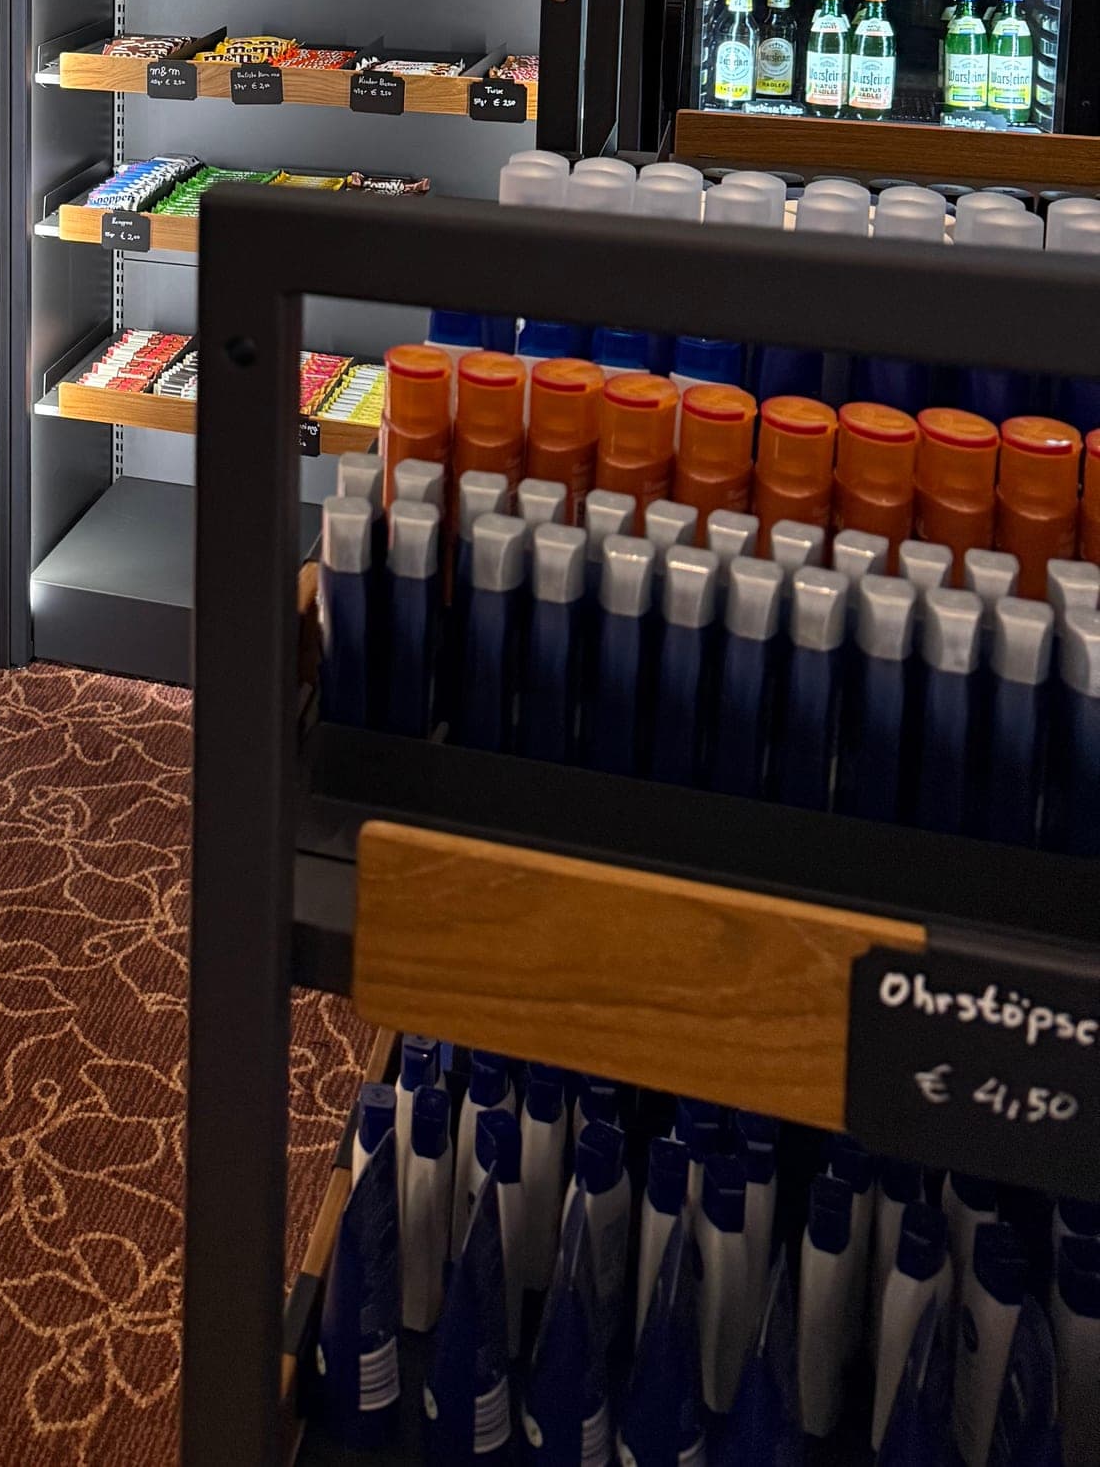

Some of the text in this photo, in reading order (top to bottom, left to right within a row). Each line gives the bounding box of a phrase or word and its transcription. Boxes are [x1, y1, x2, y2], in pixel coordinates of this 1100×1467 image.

[493, 98, 500, 106] €
[914, 1064, 1079, 1122] € 4,50
